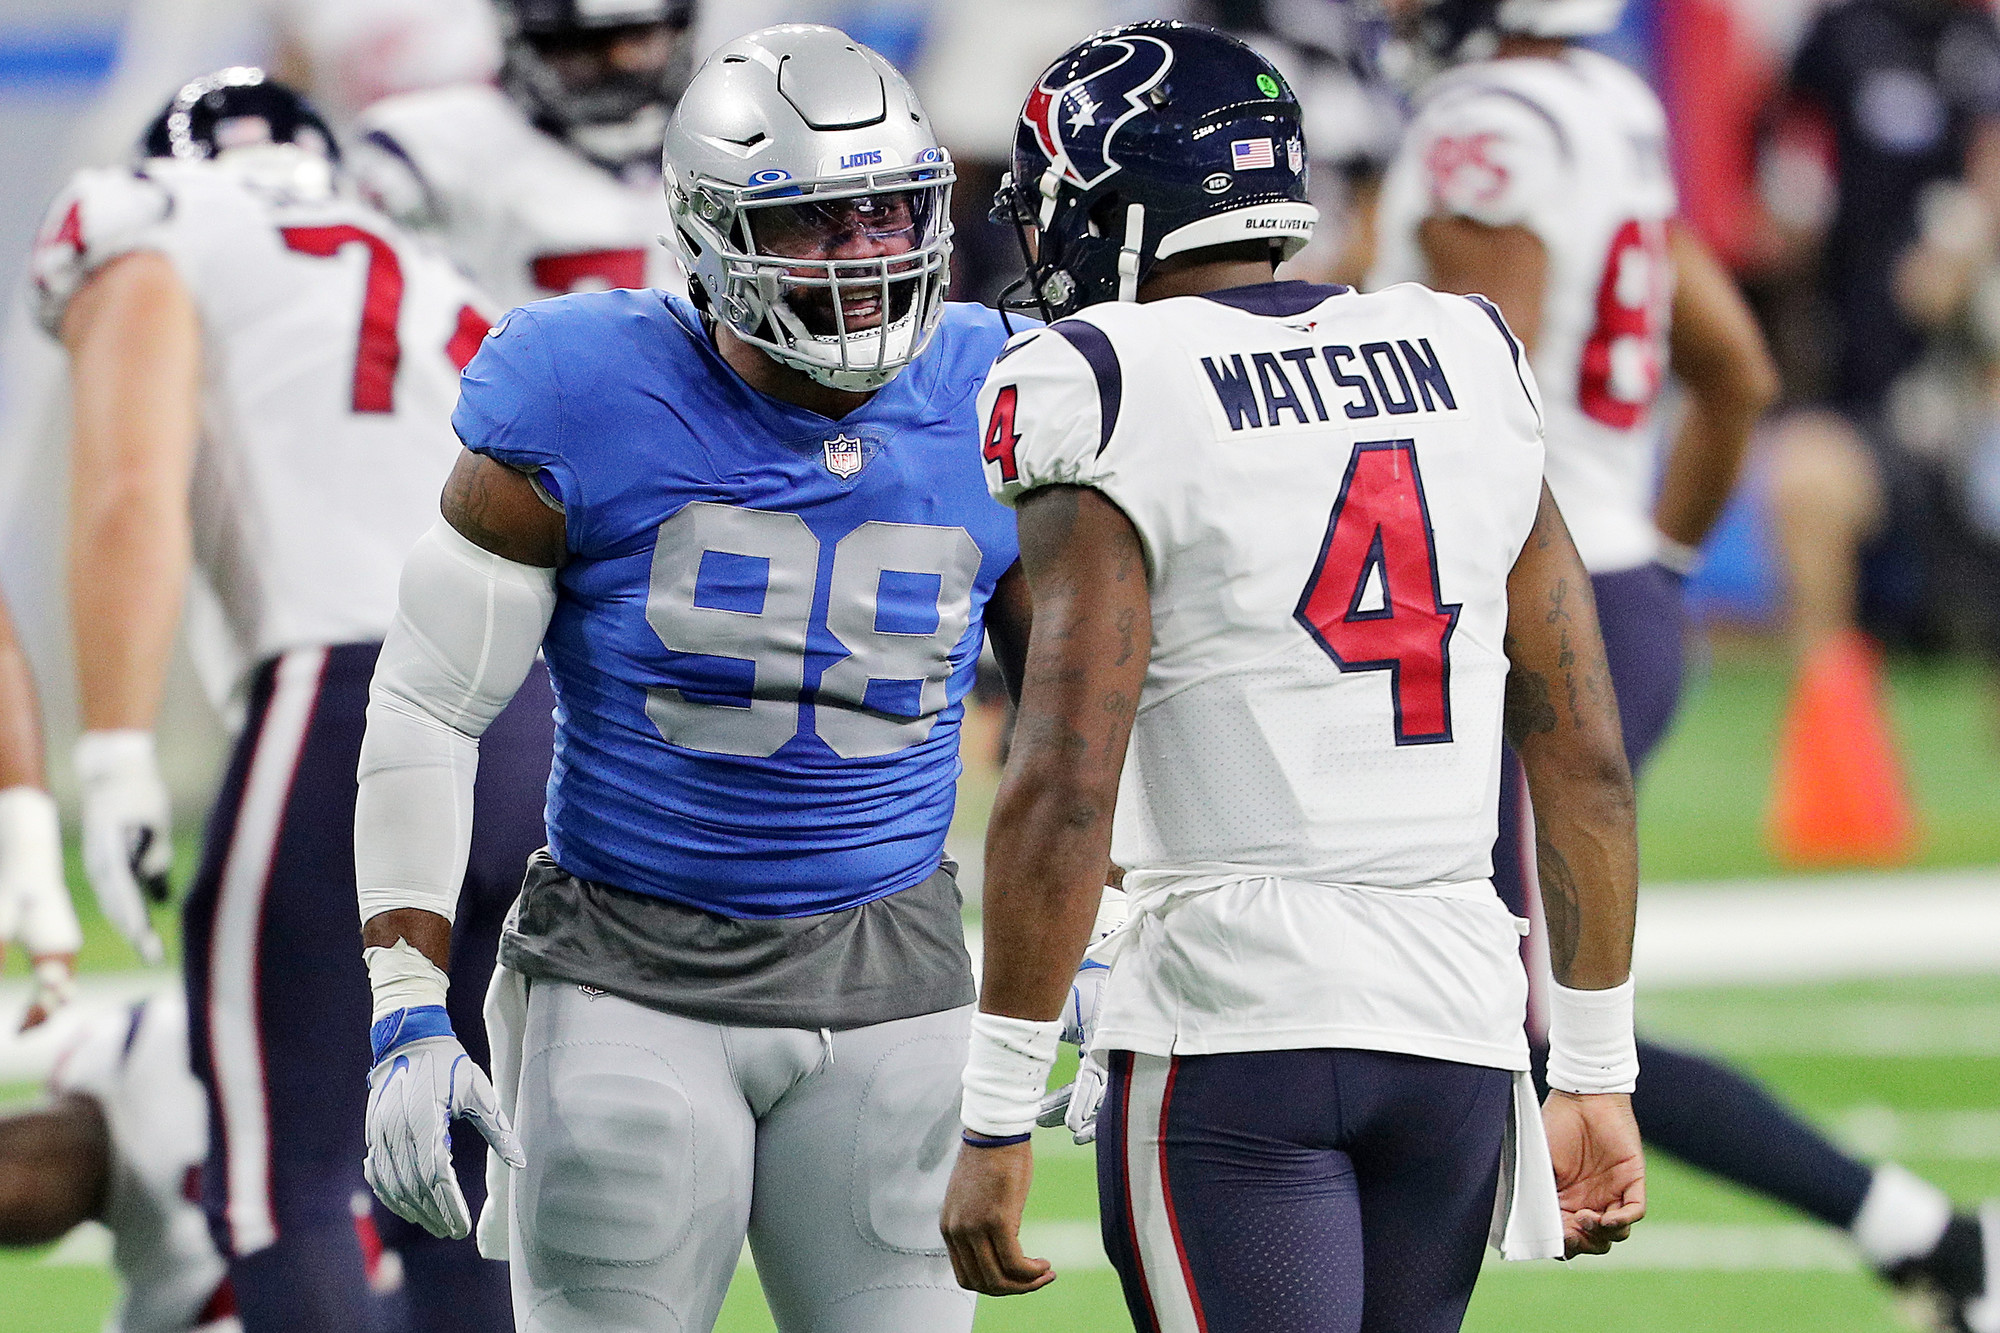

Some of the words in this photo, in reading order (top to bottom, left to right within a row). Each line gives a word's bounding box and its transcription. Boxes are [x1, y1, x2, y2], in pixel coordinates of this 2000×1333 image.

[840, 150, 882, 169] LIONS
[1246, 219, 1278, 229] BLACK
[1280, 219, 1300, 229] LIVES
[1200, 338, 1458, 431] WATSON
[832, 453, 857, 469] NFL
[983, 383, 1023, 483] 4
[645, 500, 983, 760] 98
[1292, 438, 1463, 746] 4
